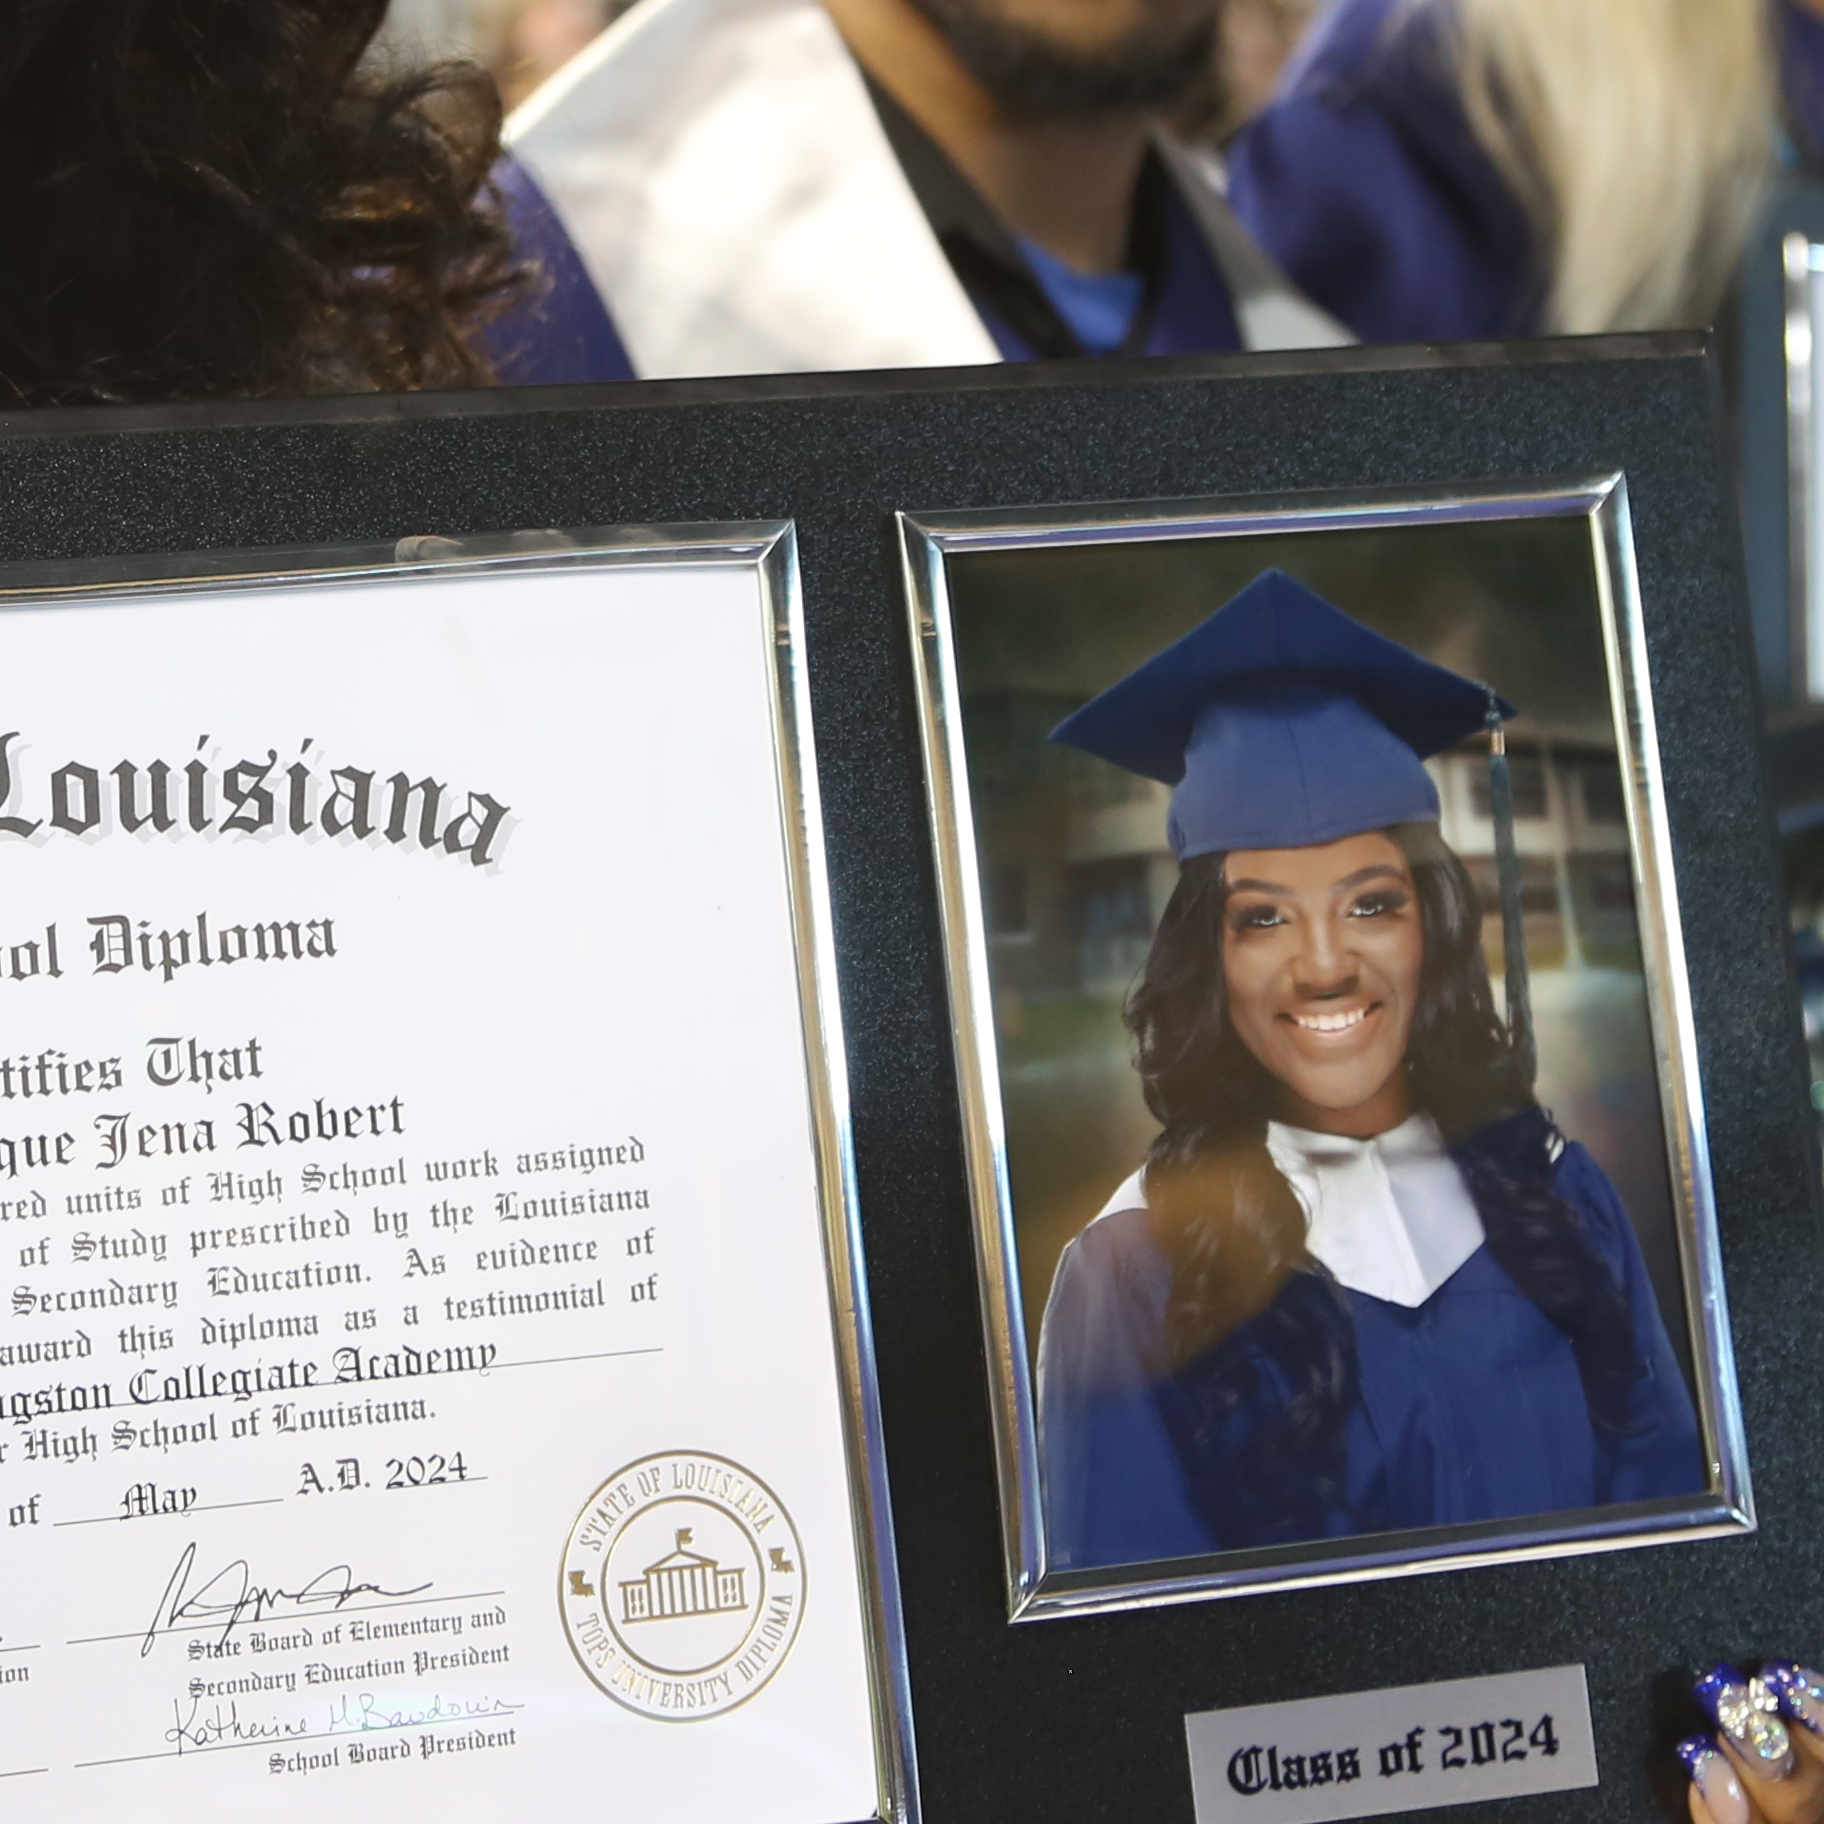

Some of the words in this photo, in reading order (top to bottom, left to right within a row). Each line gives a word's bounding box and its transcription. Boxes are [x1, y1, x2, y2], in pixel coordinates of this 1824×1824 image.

[86, 911, 338, 984] Diploma
[146, 1037, 264, 1095] That
[93, 1112, 217, 1170] Jena
[235, 1094, 405, 1150] Robert
[65, 1185, 142, 1216] units
[161, 1175, 192, 1207] of
[206, 1168, 283, 1206] High
[300, 1156, 408, 1197] School
[424, 1149, 500, 1183] work
[516, 1135, 645, 1175] assigned
[19, 1236, 52, 1268] of
[70, 1227, 168, 1263] Study
[189, 1208, 351, 1259] prescribed
[373, 1205, 409, 1240] by
[429, 1199, 474, 1234] the
[494, 1187, 650, 1222] Louisiana
[10, 1277, 178, 1317] Secondary
[206, 1260, 372, 1297] Education.
[402, 1247, 446, 1278] As
[476, 1238, 598, 1271] evidence
[626, 1226, 656, 1257] of
[117, 1324, 174, 1360] this
[199, 1312, 320, 1351] diploma
[344, 1308, 377, 1333] as
[403, 1304, 420, 1327] a
[443, 1278, 606, 1322] testimonial
[630, 1272, 659, 1304] of
[129, 1357, 319, 1405] Collegiate
[332, 1342, 496, 1381] Academy
[20, 1425, 98, 1464] High
[110, 1412, 219, 1455] School
[231, 1407, 262, 1439] of
[271, 1398, 436, 1434] Louisiana.
[8, 1493, 42, 1528] of
[119, 1481, 197, 1523] May
[296, 1457, 371, 1496] A.D.
[385, 1450, 467, 1491] 2024
[580, 1483, 636, 1552] STATE
[636, 1466, 662, 1497] OF
[672, 1462, 776, 1534] LOUISIANA
[187, 1638, 242, 1662] State
[249, 1627, 314, 1654] Board
[321, 1623, 343, 1646] of
[348, 1615, 463, 1642] Elementary
[470, 1605, 507, 1629] and
[187, 1671, 297, 1699] Secondary
[303, 1658, 406, 1685] Education
[412, 1644, 510, 1677] President
[577, 1612, 616, 1668] TOPS
[611, 1660, 734, 1709] UNIVERSITY
[735, 1593, 793, 1682] DIPLOMA
[268, 1746, 340, 1776] School
[346, 1737, 412, 1765] Board
[418, 1727, 516, 1761] President
[1226, 1744, 1361, 1796] Class
[1379, 1726, 1426, 1777] of
[1438, 1713, 1559, 1771] 2024
